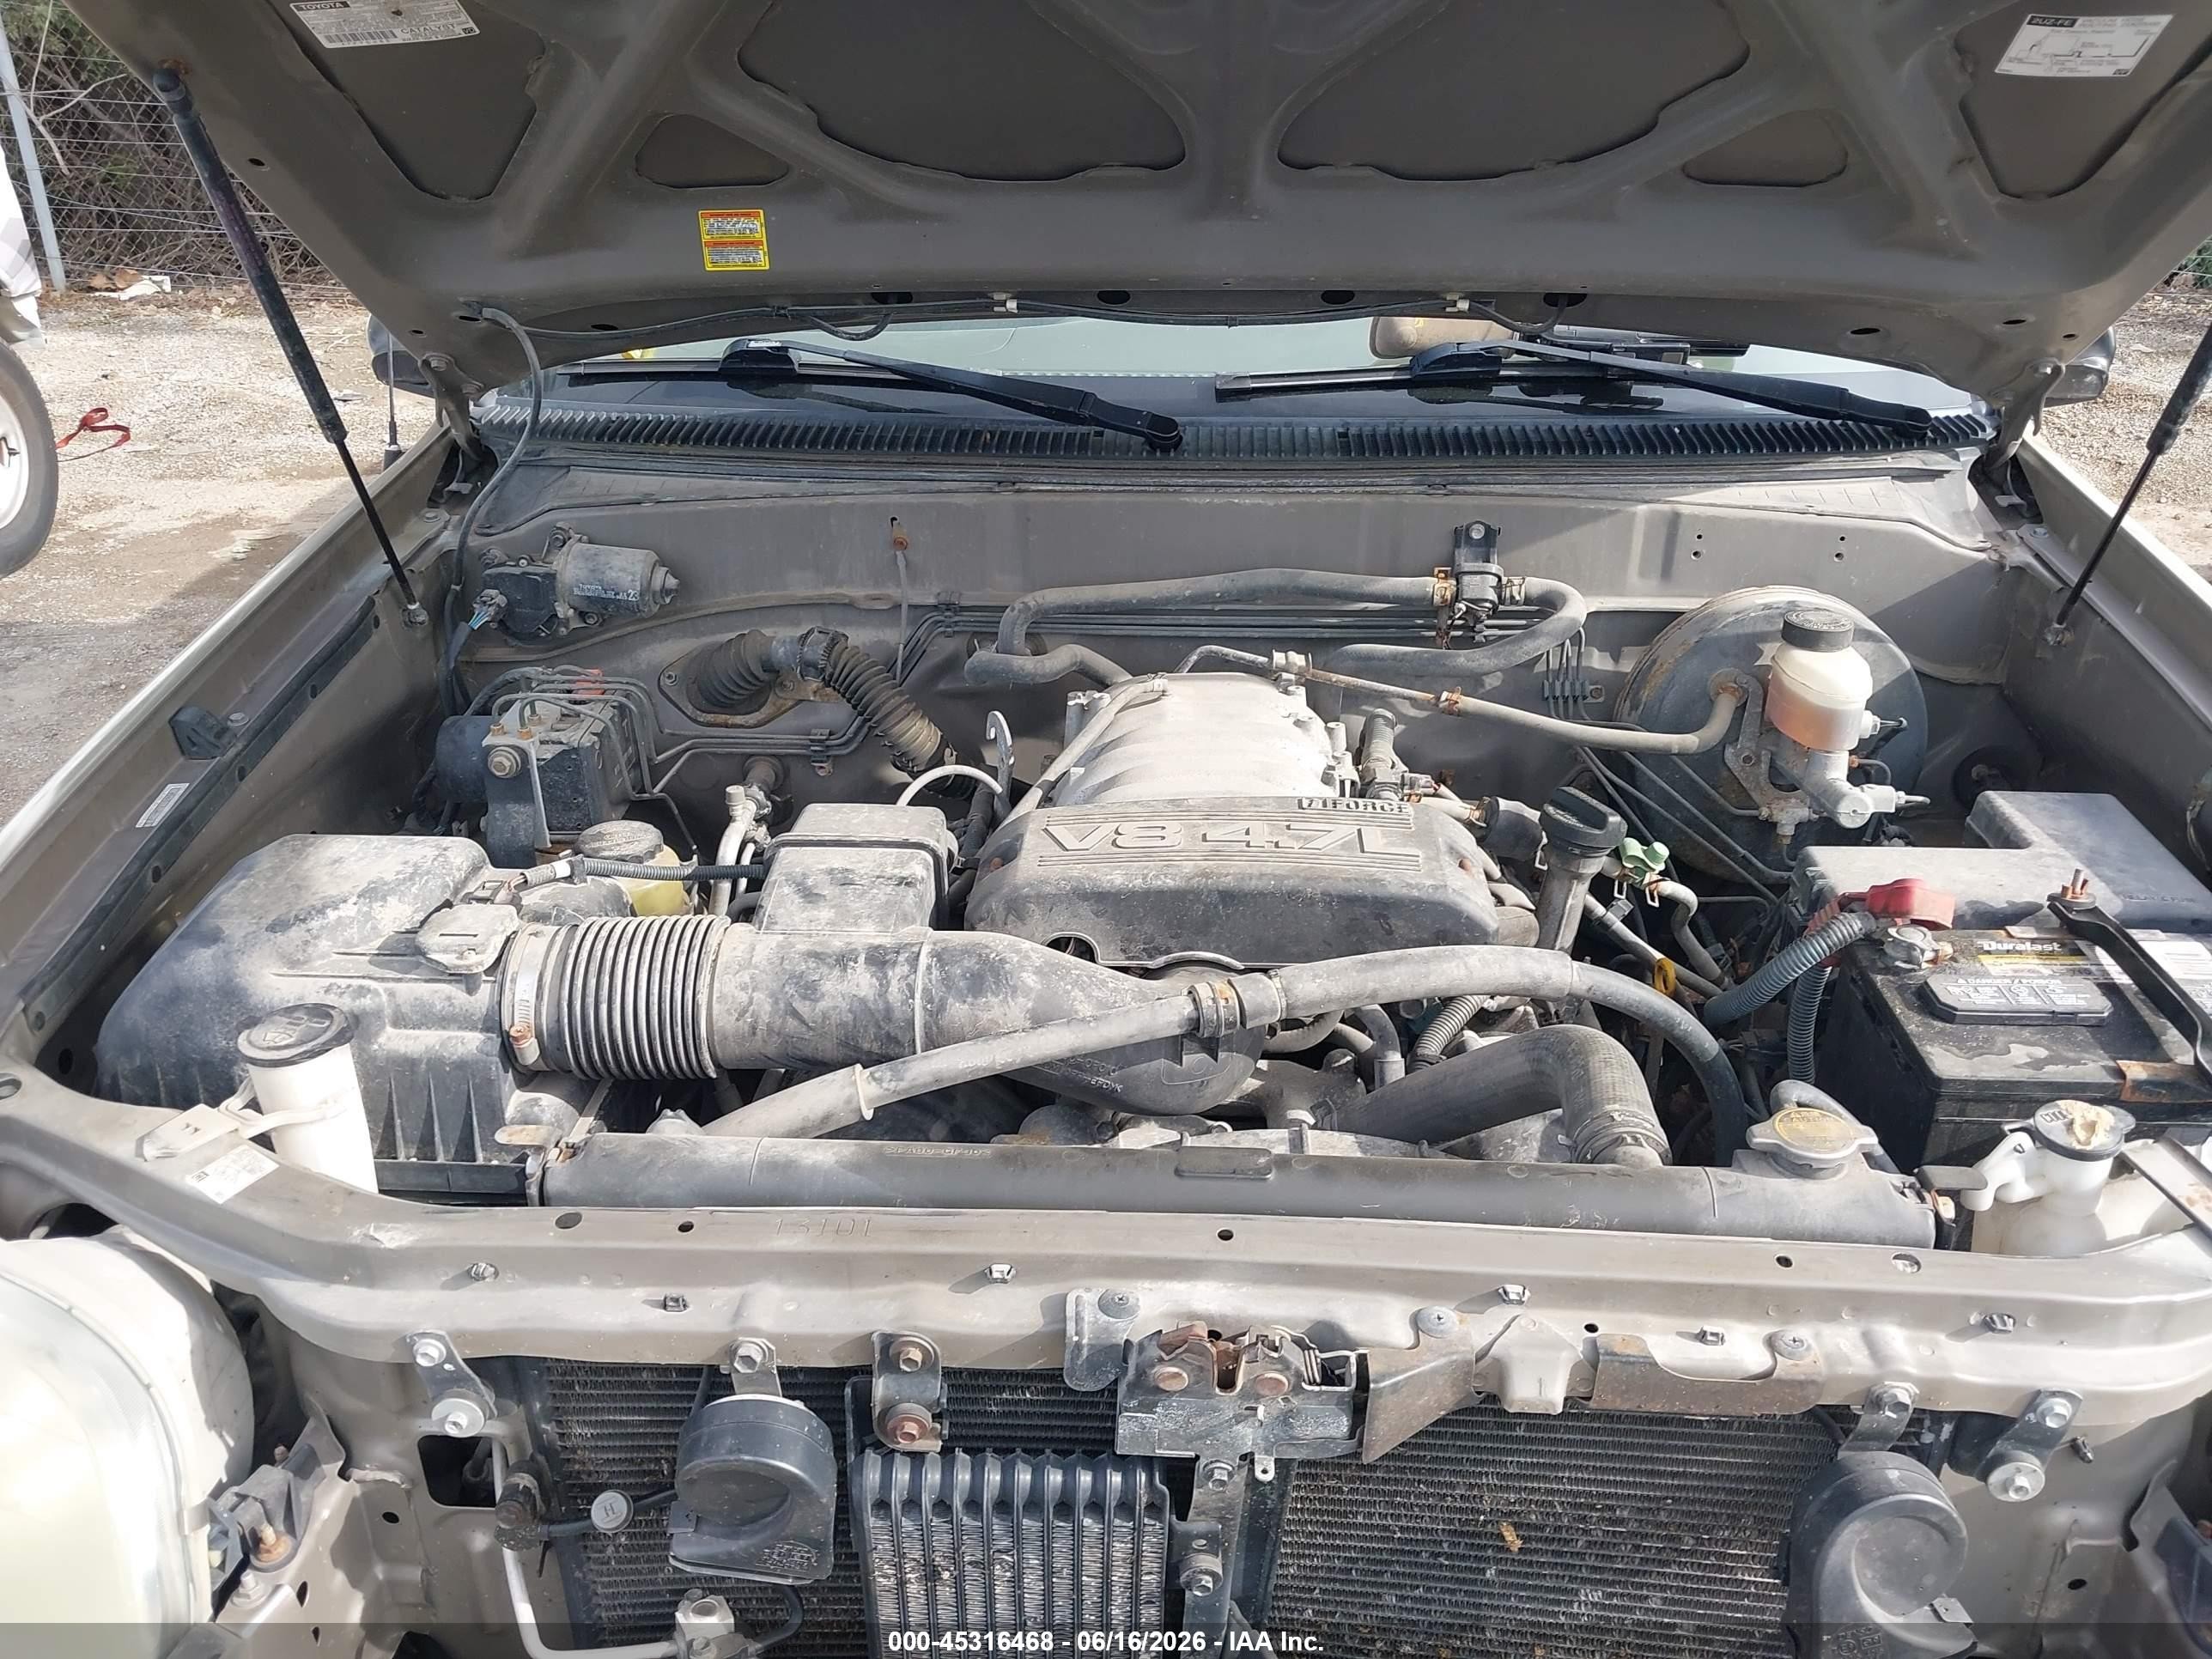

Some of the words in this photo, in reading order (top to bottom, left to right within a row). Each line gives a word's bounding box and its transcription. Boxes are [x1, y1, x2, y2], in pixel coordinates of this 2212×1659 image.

[2031, 17, 2073, 27] 2UZ-FE
[400, 23, 456, 34] CATALYST
[1042, 823, 1182, 852] V8
[1201, 823, 1422, 857] 4.7L
[1983, 940, 2063, 952] Duralast
